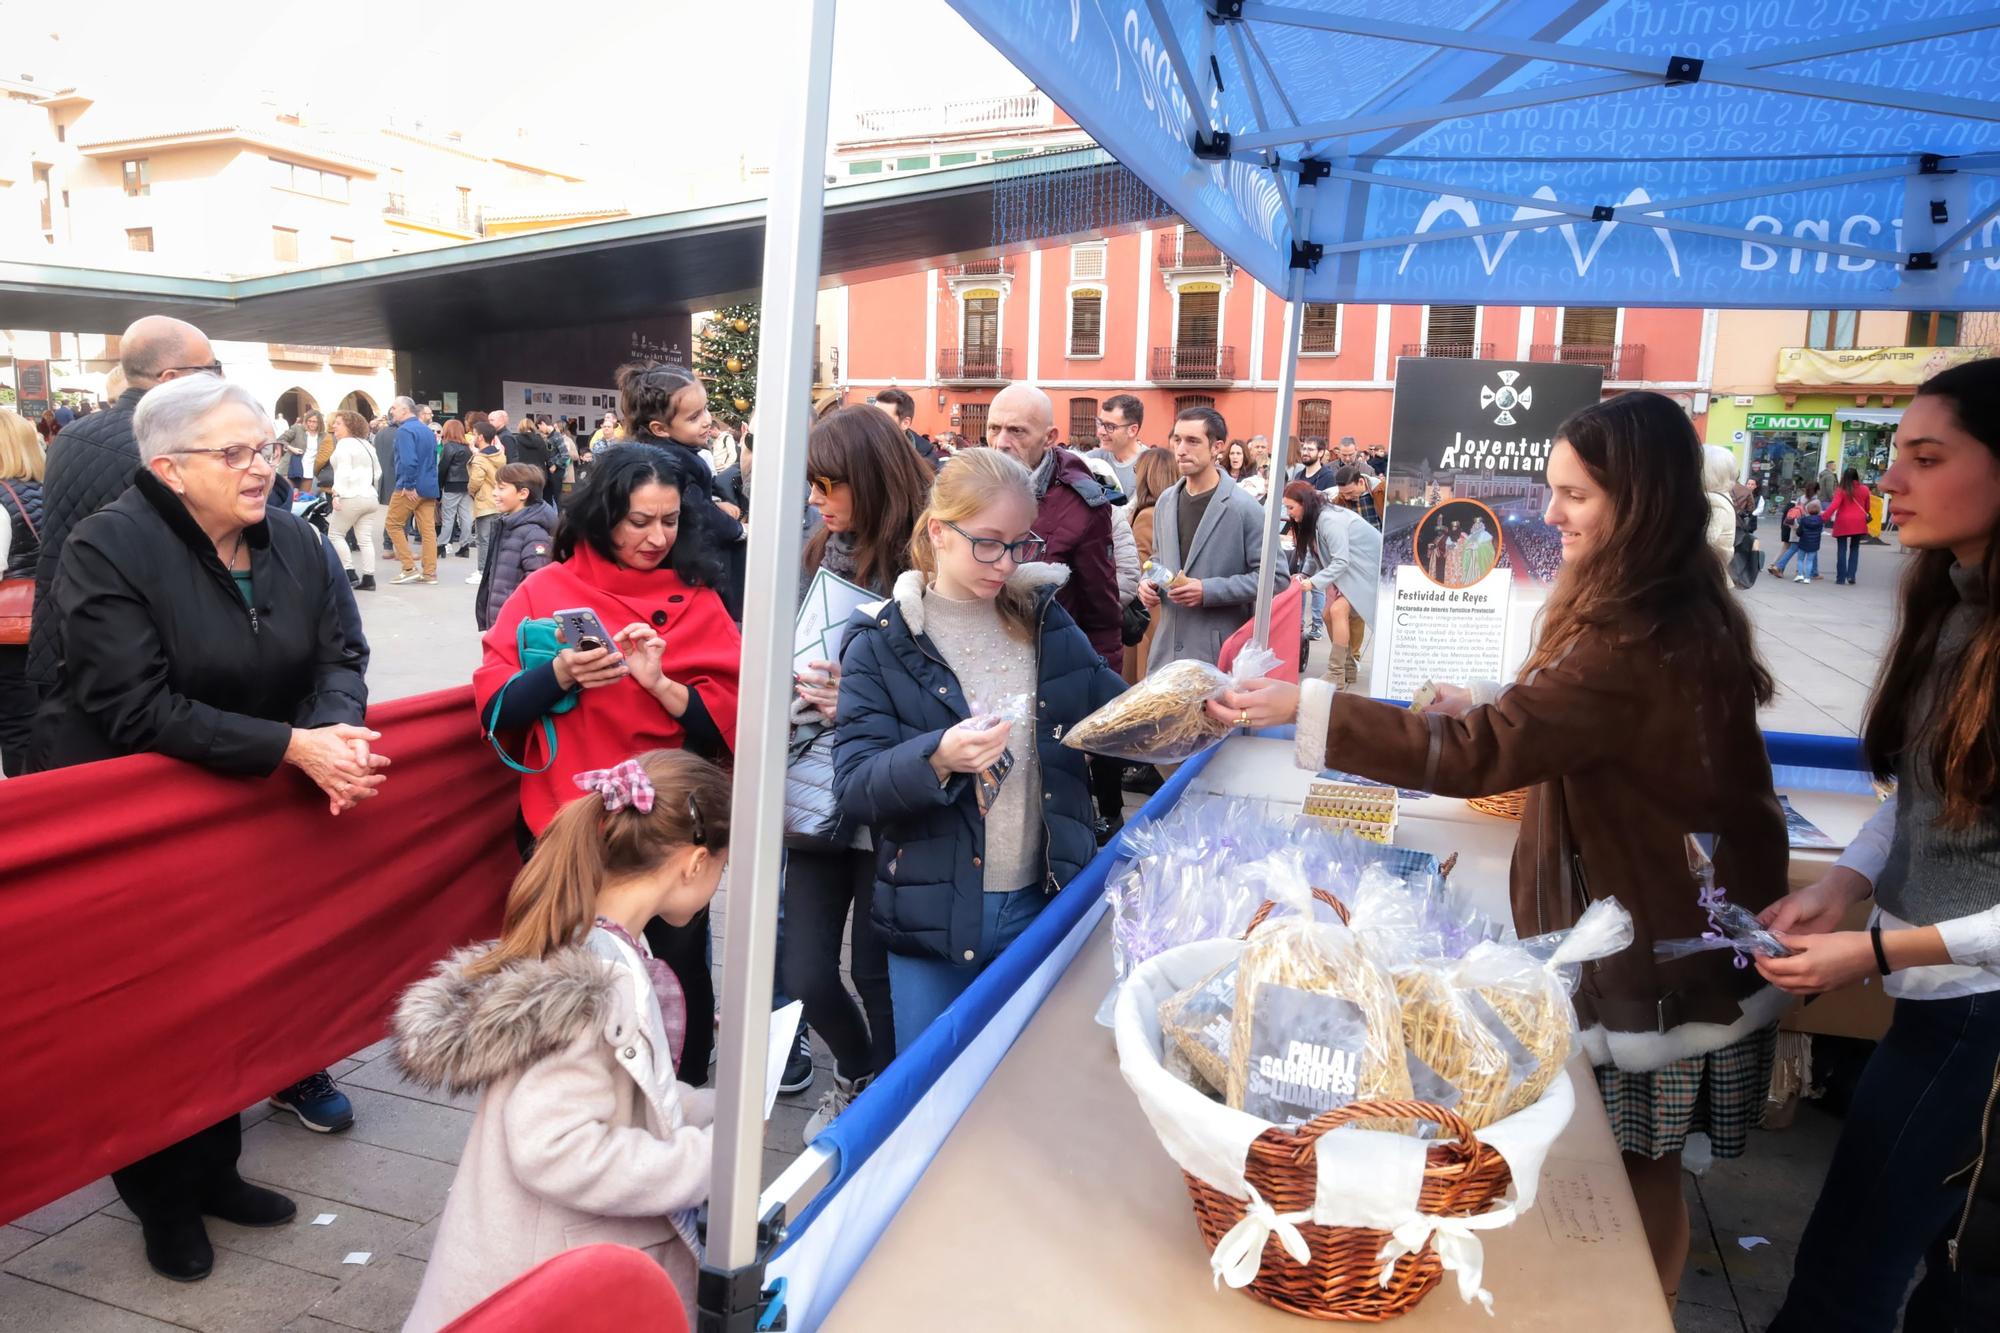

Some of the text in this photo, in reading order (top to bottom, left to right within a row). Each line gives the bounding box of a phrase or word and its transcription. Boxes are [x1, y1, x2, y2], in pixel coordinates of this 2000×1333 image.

[1768, 417, 1829, 428] MOVIL
[1452, 432, 1552, 457] Joventut
[1440, 446, 1545, 471] Antonian
[1398, 589, 1488, 604] Festividad de Reyes
[1260, 1054, 1356, 1096] GARROFES
